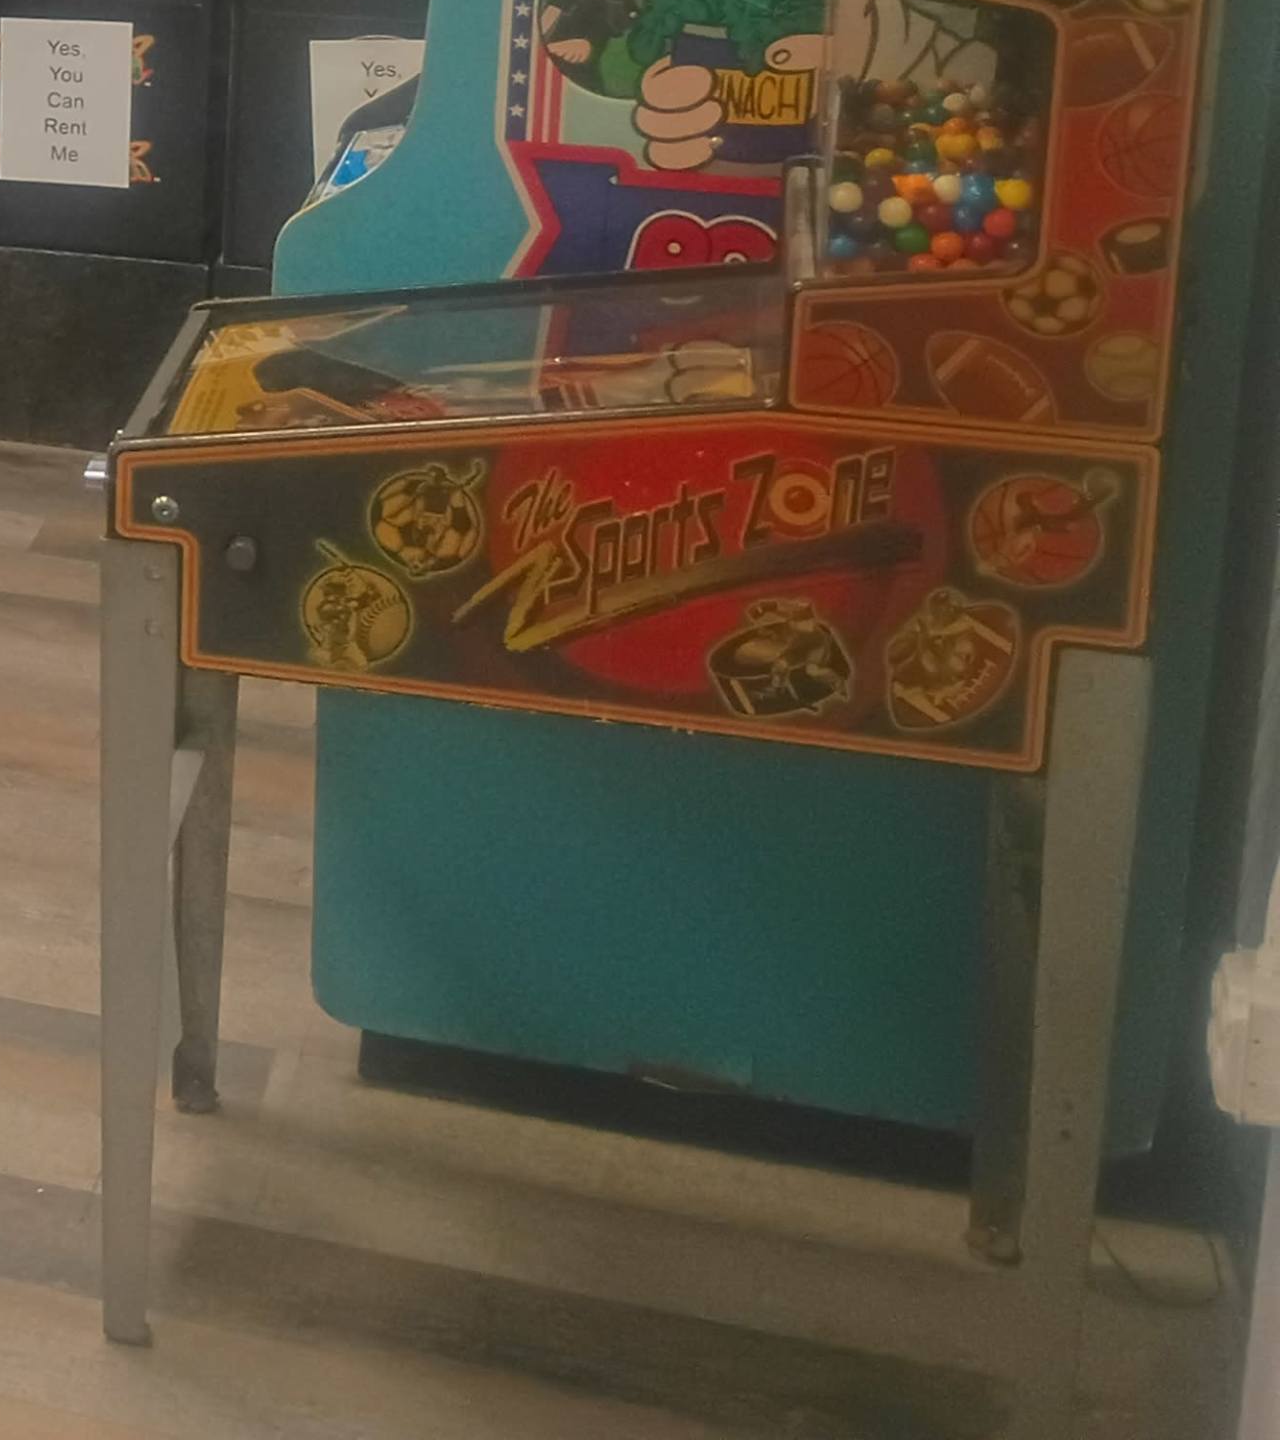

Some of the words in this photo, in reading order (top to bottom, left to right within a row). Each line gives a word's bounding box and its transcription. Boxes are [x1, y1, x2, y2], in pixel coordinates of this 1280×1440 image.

[49, 66, 84, 83] You
[360, 61, 402, 80] Yes,
[47, 91, 85, 109] Can
[43, 117, 88, 136] Rent
[50, 144, 79, 162] Me
[502, 465, 573, 552] The
[544, 480, 726, 615] Sports
